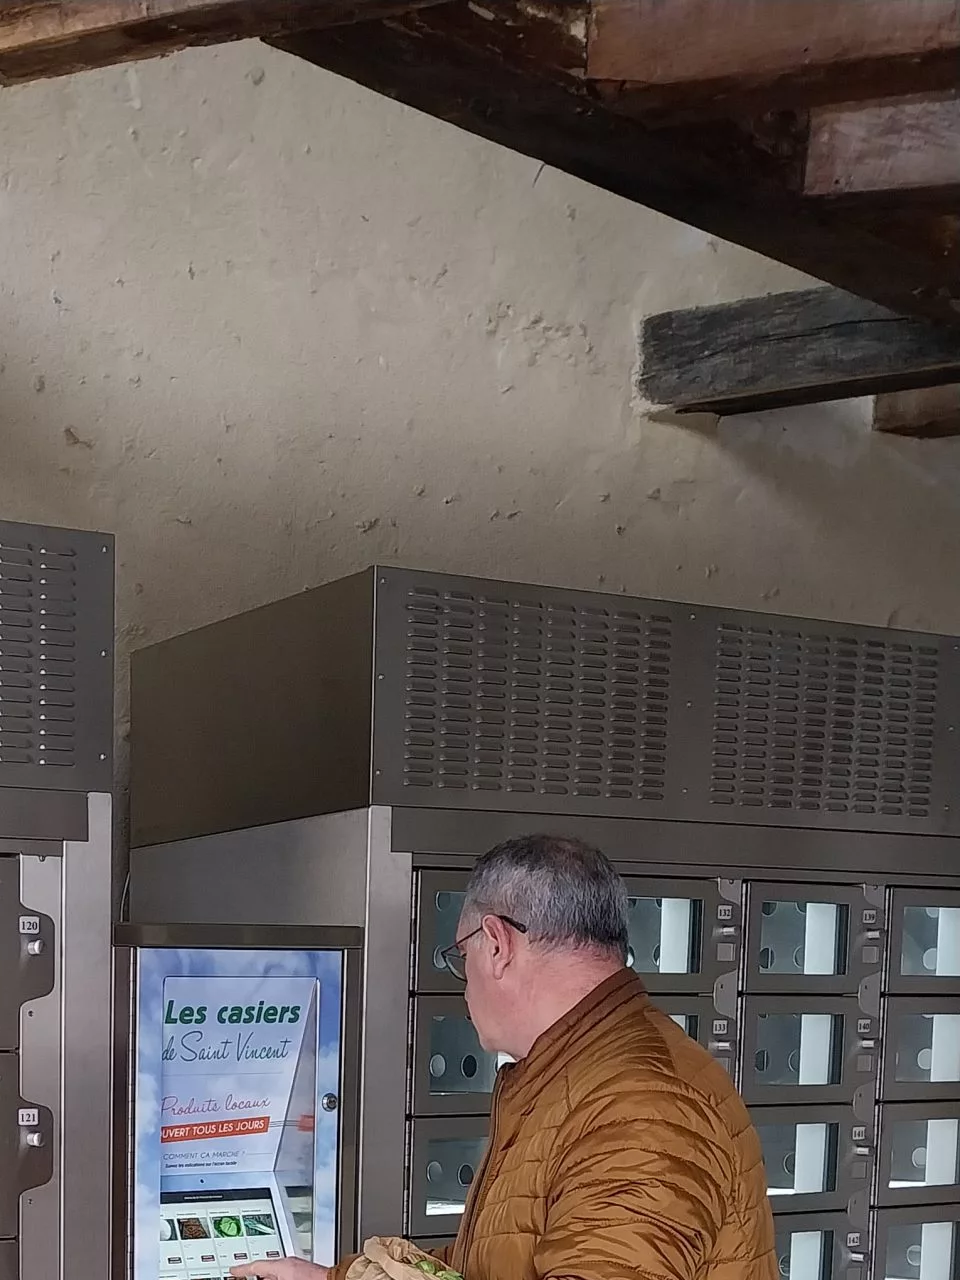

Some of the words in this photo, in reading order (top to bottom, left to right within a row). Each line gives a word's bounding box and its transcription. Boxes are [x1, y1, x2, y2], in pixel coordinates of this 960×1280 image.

[21, 920, 38, 931] 120
[164, 999, 207, 1024] Les
[216, 1000, 301, 1024] casiers
[714, 1022, 726, 1032] 133
[161, 1035, 177, 1062] de
[180, 1030, 233, 1062] Saint
[235, 1031, 292, 1062] Vincent
[160, 1095, 221, 1117] Produits
[225, 1093, 271, 1111] locaux
[20, 1112, 36, 1122] 121
[193, 1124, 217, 1136] TOUS
[218, 1122, 234, 1133] LES
[235, 1120, 265, 1131] JOURS
[163, 1152, 198, 1161] COMMENT
